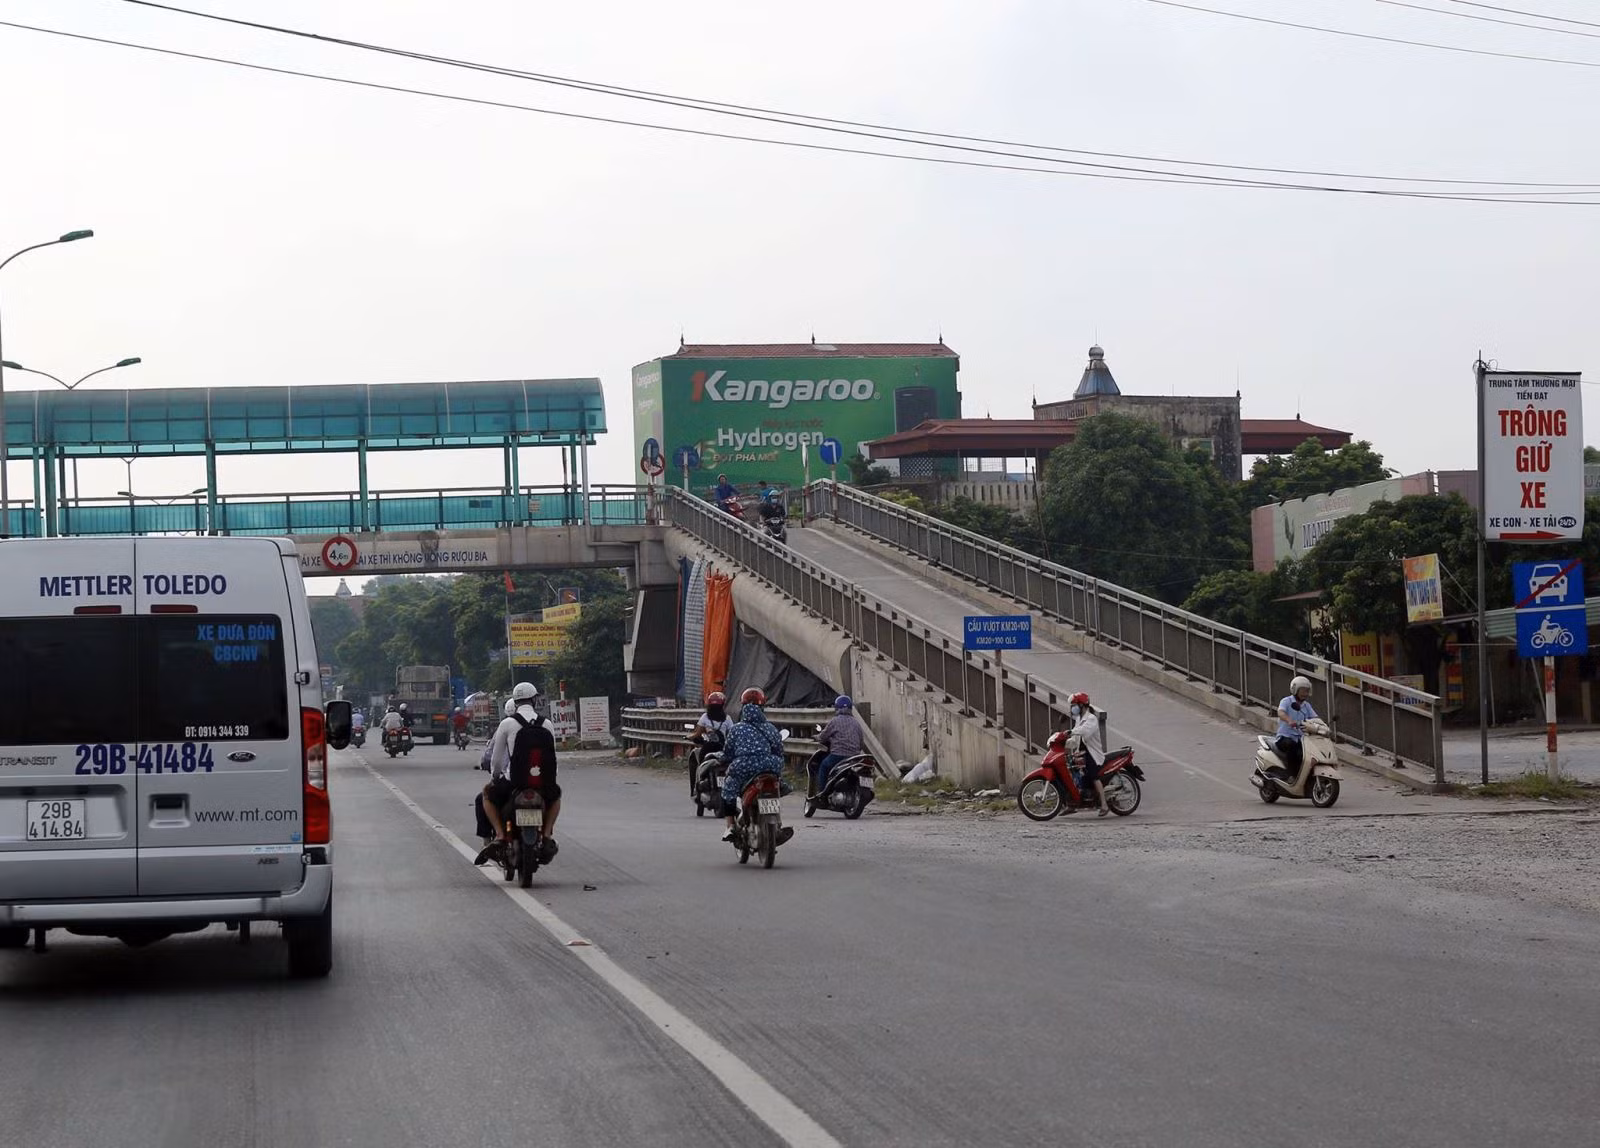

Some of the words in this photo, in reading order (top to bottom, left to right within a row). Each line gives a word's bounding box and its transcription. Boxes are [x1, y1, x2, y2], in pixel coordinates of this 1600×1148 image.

[1488, 379, 1512, 388] TRUNG
[1514, 377, 1529, 388] TÂM
[1531, 378, 1560, 388] THƯƠNG
[1561, 379, 1576, 390] MẠI
[1498, 404, 1568, 437] TRÔNG
[717, 427, 824, 451] Hydrogen
[1515, 440, 1553, 473] GIỮ
[1520, 482, 1546, 509] XE
[1489, 517, 1501, 528] XE
[1503, 517, 1521, 528] CON
[1529, 517, 1541, 528] XE
[1543, 514, 1557, 528] TẢI
[368, 553, 379, 565] XE
[379, 552, 391, 565] THÌ
[392, 551, 423, 564] KHÔNG
[475, 551, 488, 562] BIA
[40, 576, 133, 597] METTLER
[143, 574, 228, 595] TOLEDO
[197, 624, 214, 641] XE
[217, 623, 245, 641] ĐƯA
[247, 621, 276, 641] ĐÓN
[214, 645, 258, 662] CBCNV
[185, 726, 197, 738] ĐT:
[198, 726, 217, 738] 0914
[219, 725, 233, 737] 344
[234, 725, 249, 737] 339
[75, 742, 215, 775] 29B-41484
[41, 802, 72, 820] 29B
[195, 807, 298, 823] www.mt.com
[29, 820, 83, 838] 414.84
